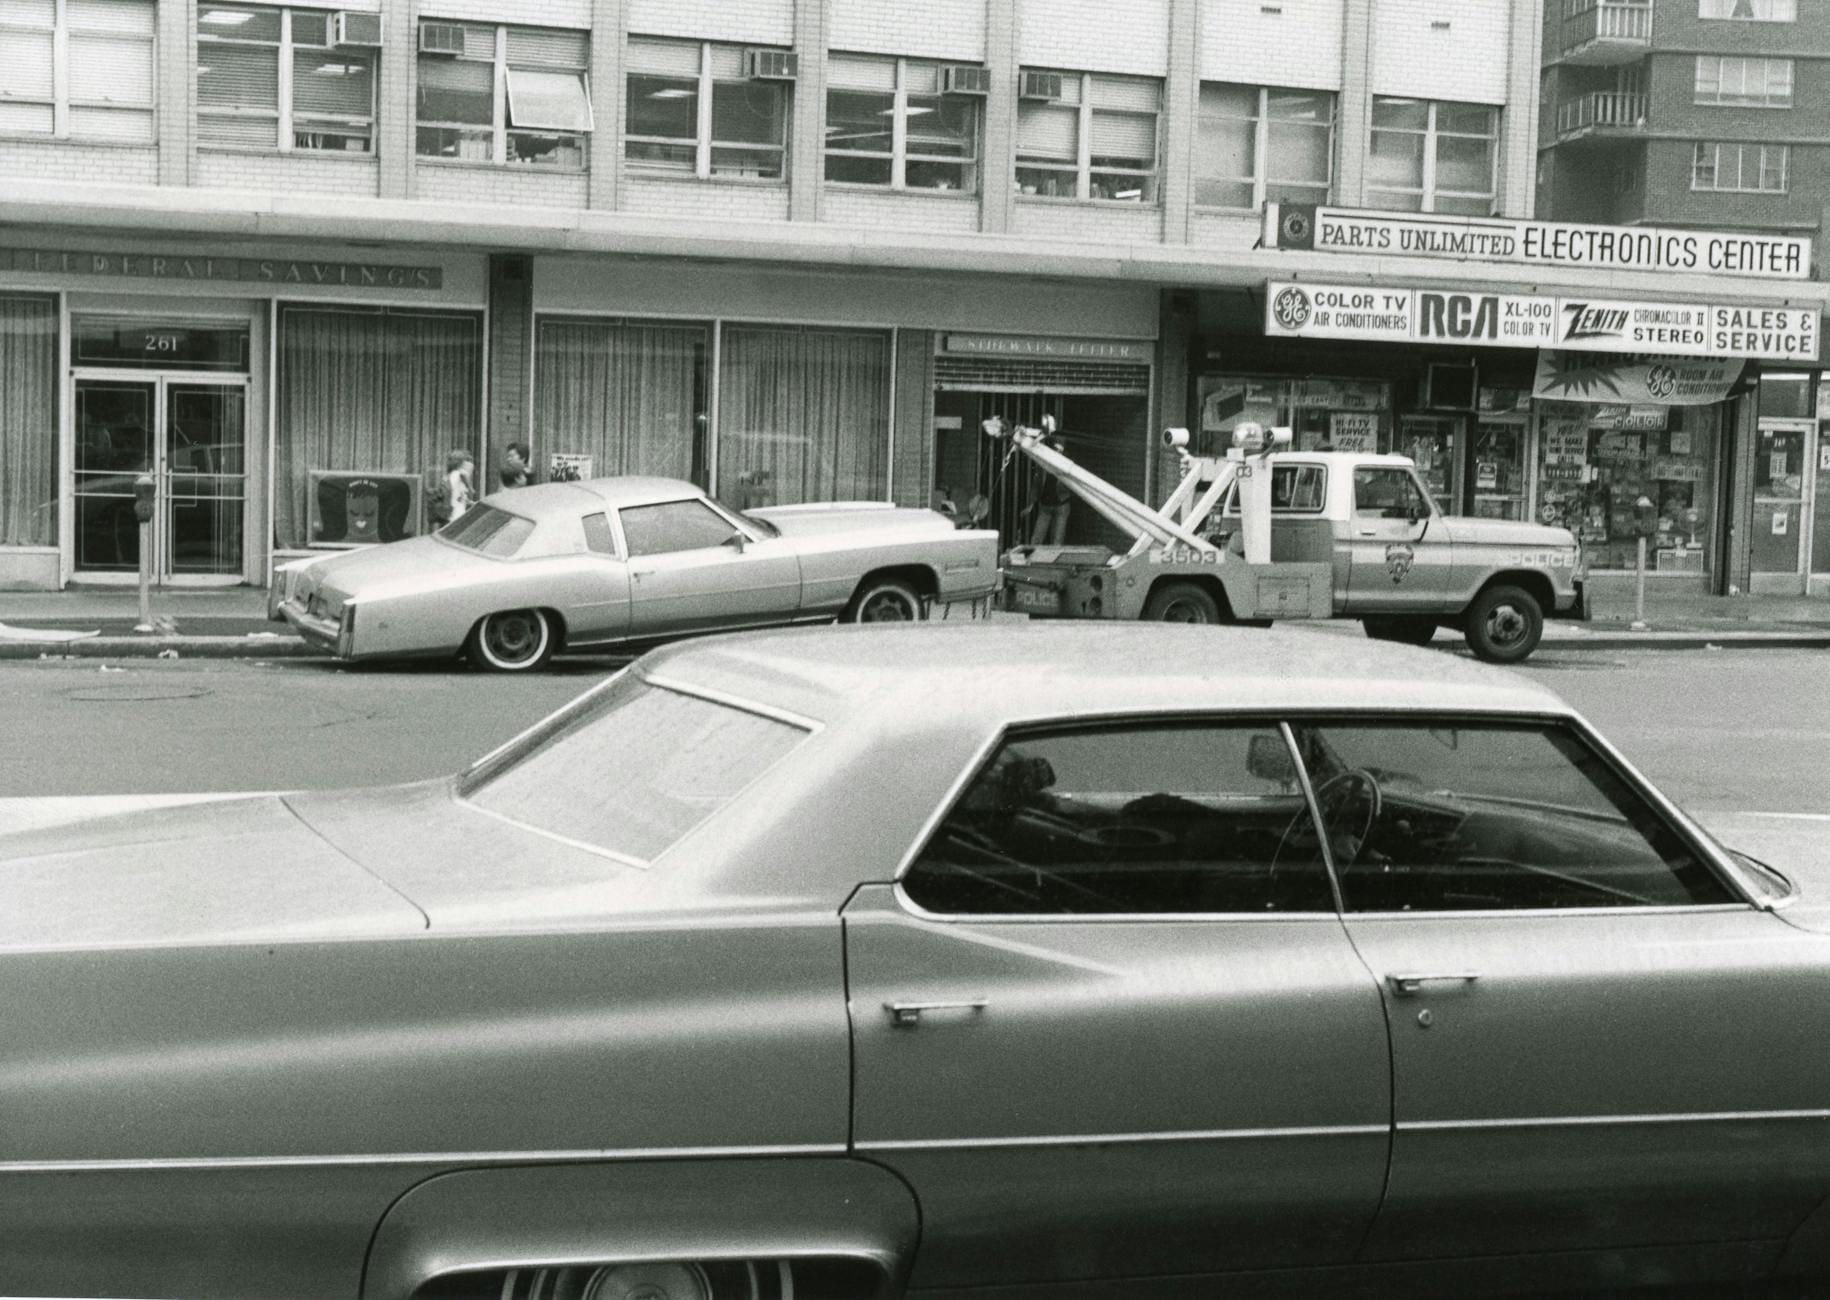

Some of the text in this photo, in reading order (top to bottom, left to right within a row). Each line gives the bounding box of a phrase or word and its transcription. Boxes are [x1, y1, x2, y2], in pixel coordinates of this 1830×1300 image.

[1321, 223, 1391, 249] PARTS
[1400, 228, 1515, 256] UNLIMITED
[1523, 227, 1697, 268] ELECTRONICS
[1708, 238, 1800, 273] CENTER
[1314, 292, 1407, 311] COLOR TV
[1505, 301, 1551, 318] XL-100
[1313, 312, 1407, 330] AIR CONDITIONERS
[1420, 293, 1499, 339] RCA
[1563, 303, 1630, 341] ZENITH
[1717, 309, 1813, 331] SALES &
[1503, 320, 1551, 337] COLOR TV
[1633, 327, 1704, 344] STEREO
[145, 335, 177, 351] 261
[1716, 331, 1813, 353] SERVICE
[1160, 549, 1217, 564] 3503
[1015, 590, 1058, 608] POLICE
